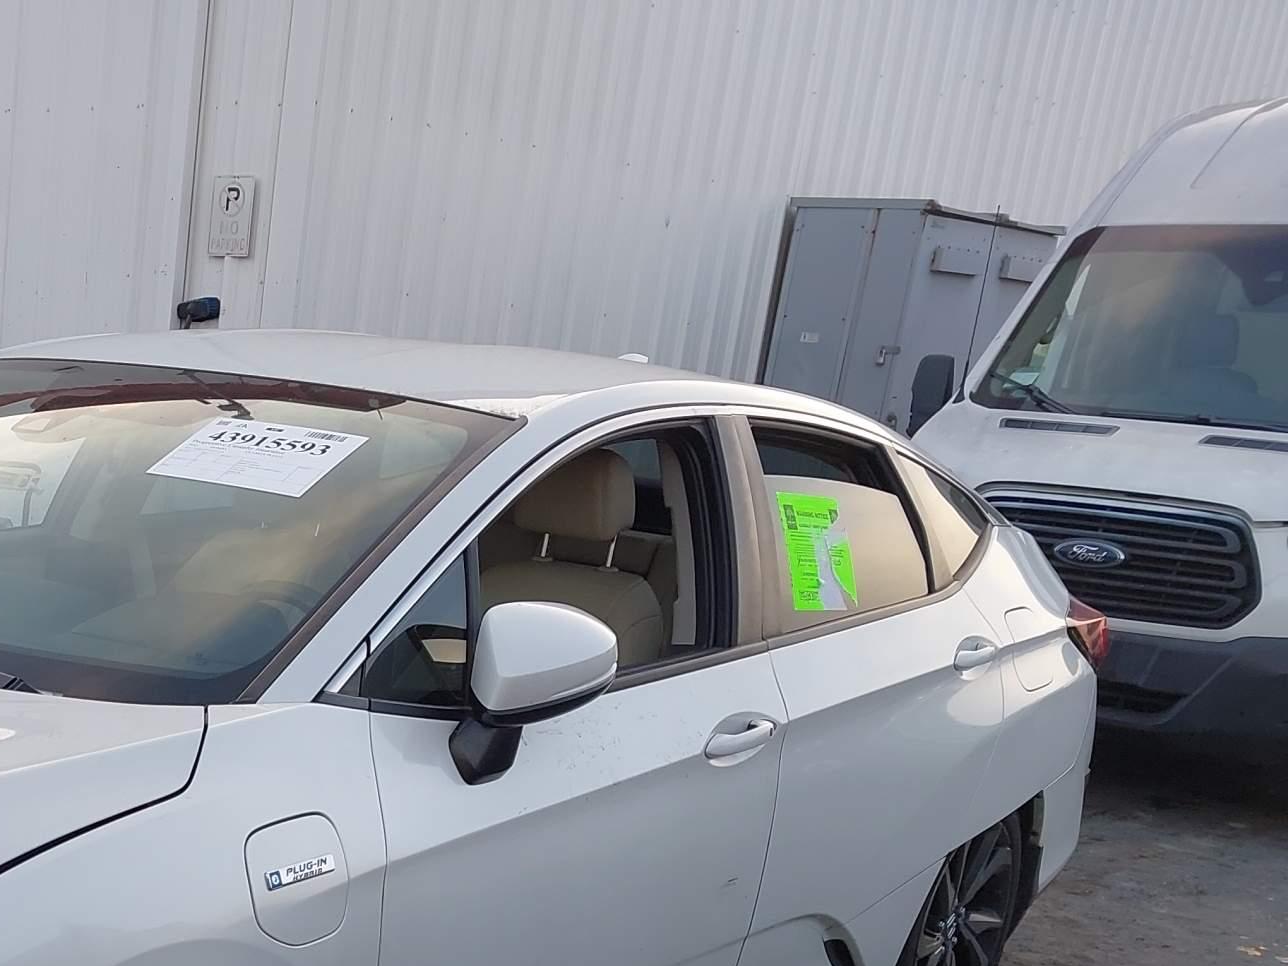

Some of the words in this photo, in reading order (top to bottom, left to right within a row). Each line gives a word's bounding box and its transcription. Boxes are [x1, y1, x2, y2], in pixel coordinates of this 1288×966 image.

[225, 186, 241, 212] P
[219, 220, 239, 235] NO
[209, 430, 331, 456] 43915593
[1067, 544, 1108, 562] Ford
[286, 856, 328, 877] PLUG-IN
